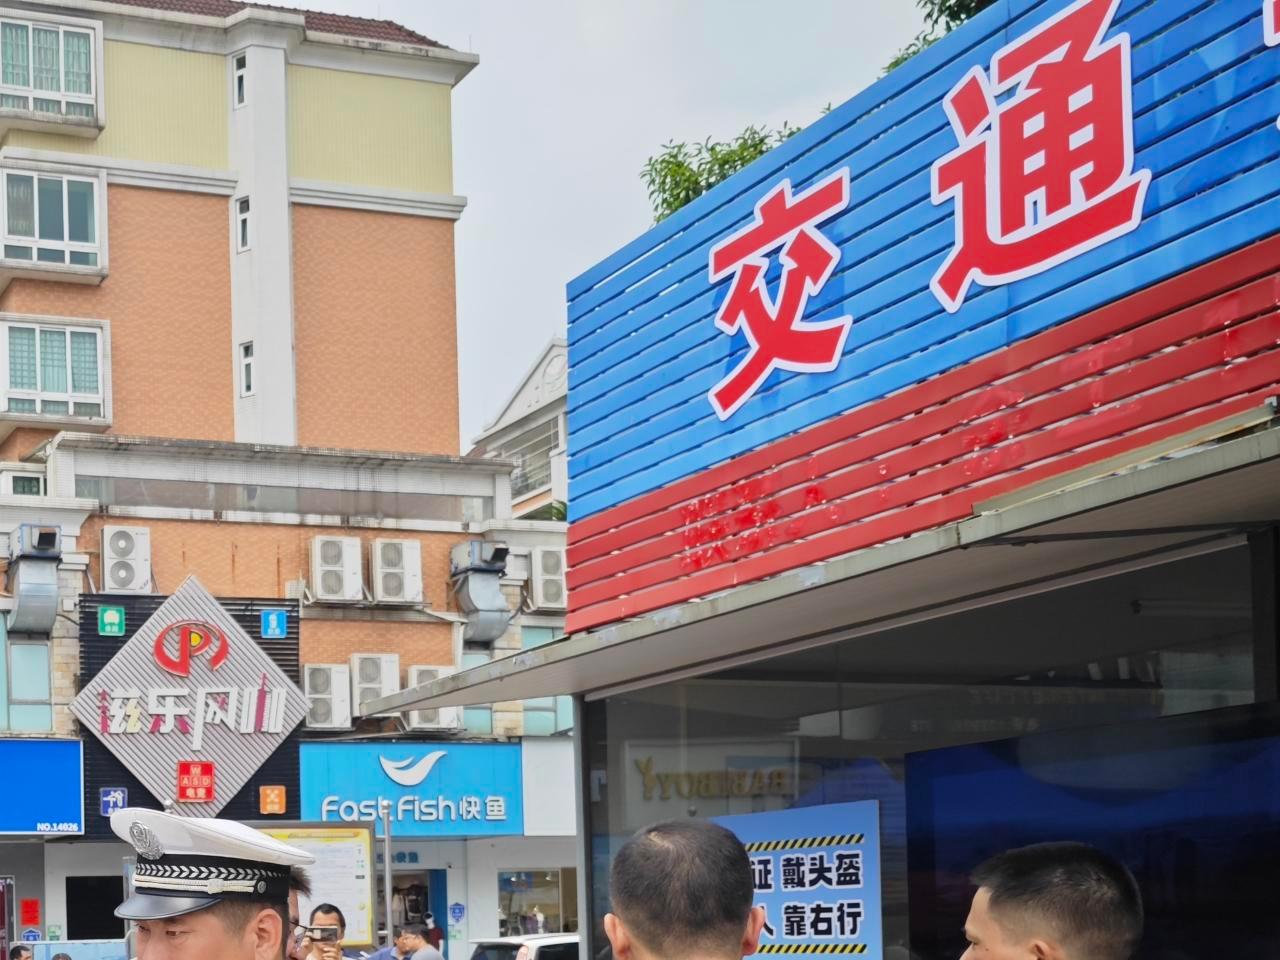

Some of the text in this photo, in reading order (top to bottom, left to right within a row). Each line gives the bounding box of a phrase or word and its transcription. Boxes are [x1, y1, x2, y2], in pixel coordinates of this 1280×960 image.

[709, 0, 1280, 420] 交通
[459, 796, 507, 820] 快鱼
[782, 853, 861, 888] 戴头盔
[783, 902, 862, 937] 靠右行
